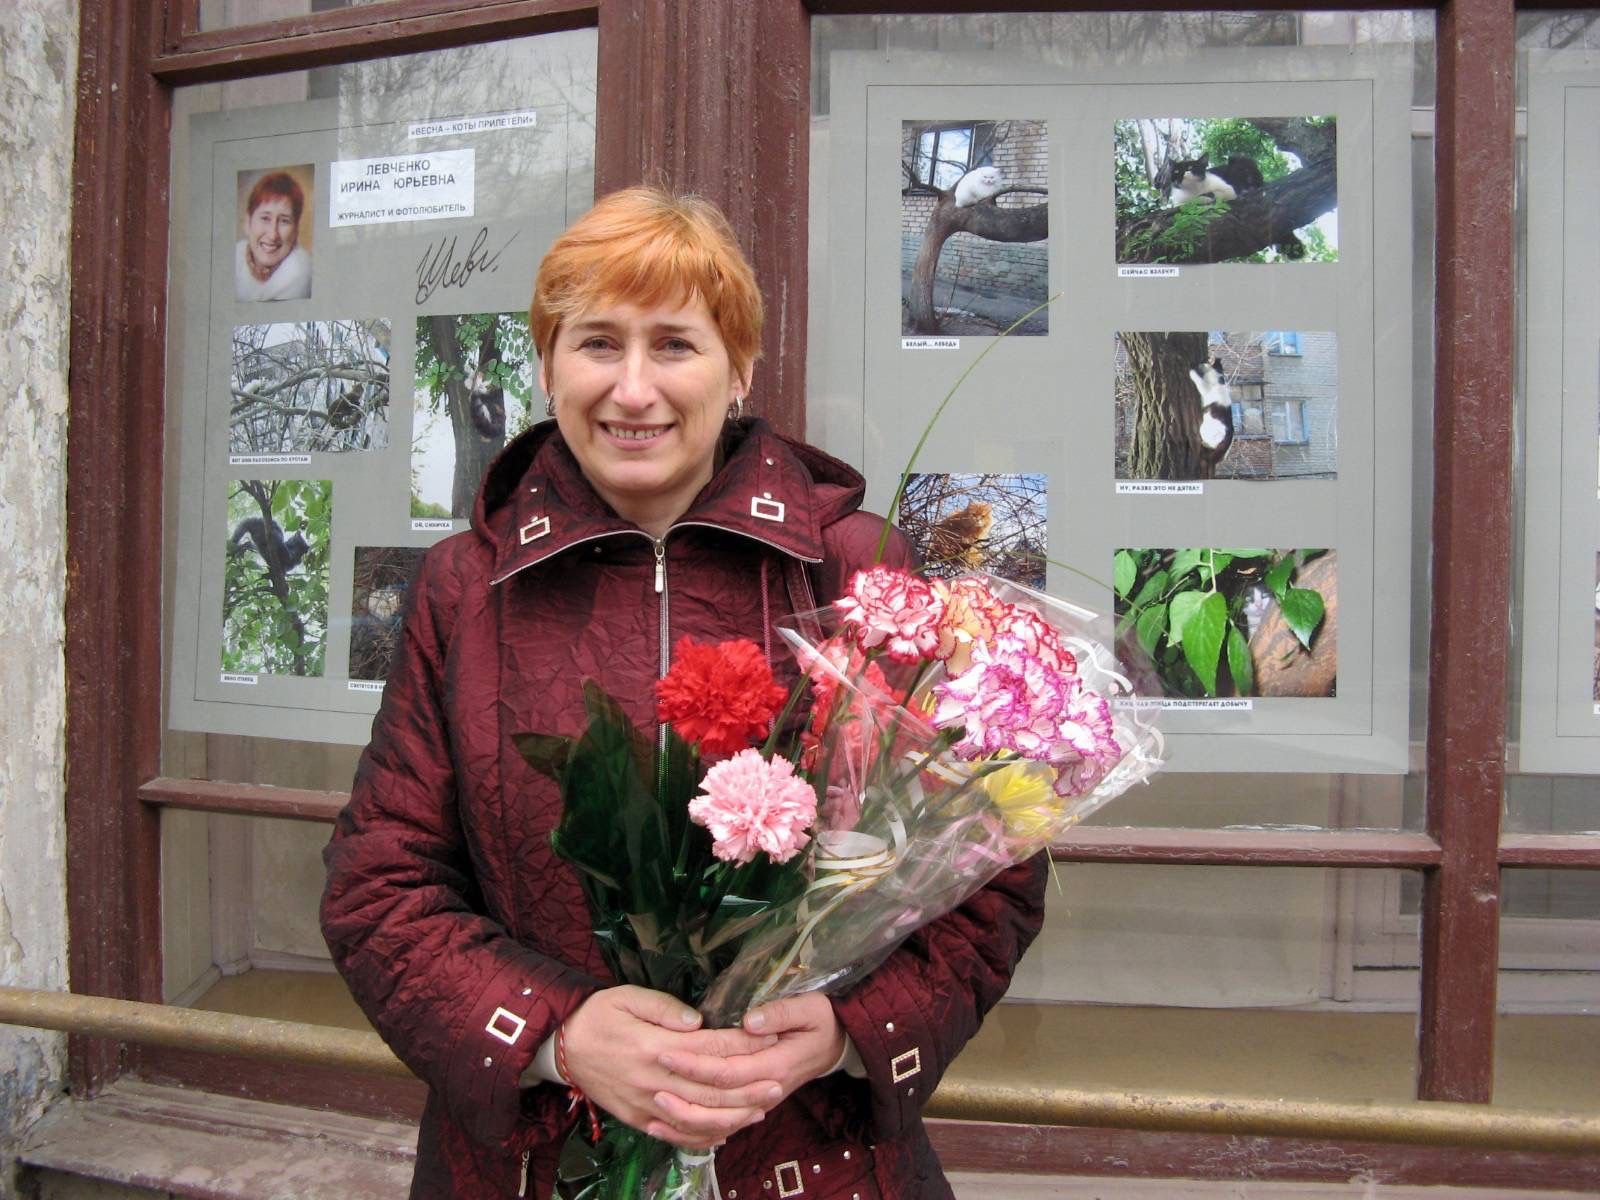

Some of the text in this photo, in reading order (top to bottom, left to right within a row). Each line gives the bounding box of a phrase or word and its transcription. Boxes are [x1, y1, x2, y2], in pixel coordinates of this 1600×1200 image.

[452, 122, 477, 132] КОТЫ
[366, 159, 431, 176] ЛЕВЧЕНКО
[340, 173, 456, 193] ИРИНА ЮРЬЕВНА
[337, 203, 467, 221] ЖУРНАЛИСТ И ФОТОЛЮБИТЕЛЬ
